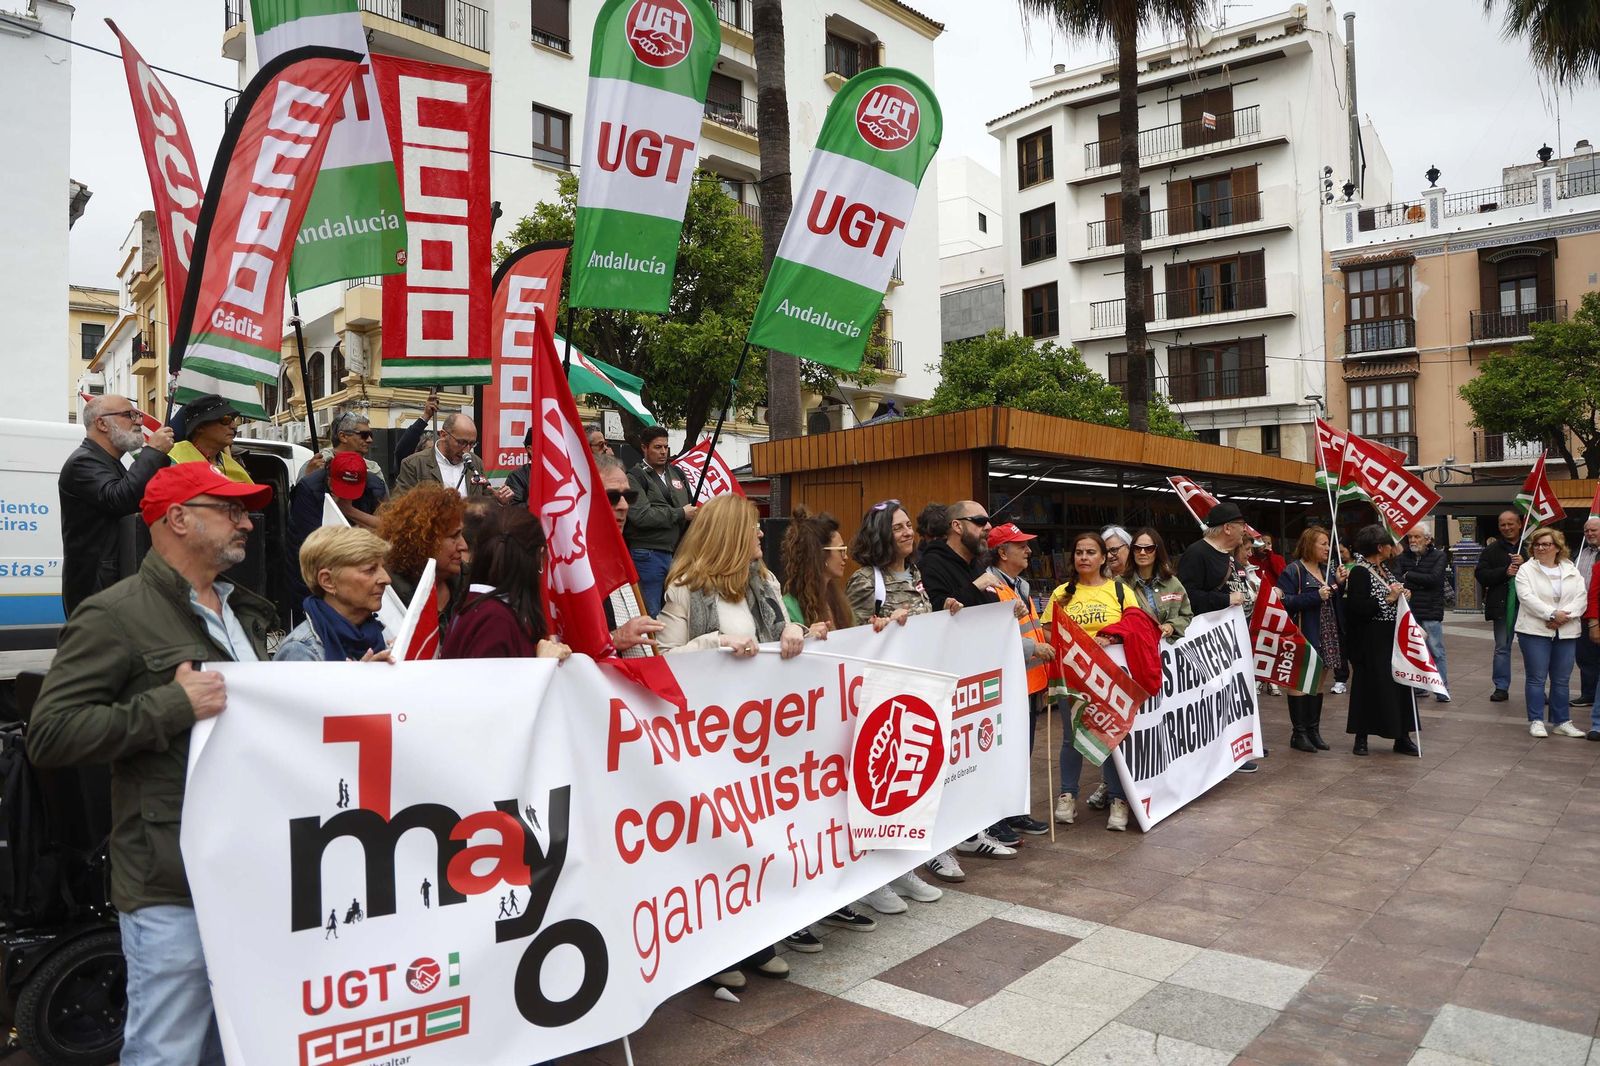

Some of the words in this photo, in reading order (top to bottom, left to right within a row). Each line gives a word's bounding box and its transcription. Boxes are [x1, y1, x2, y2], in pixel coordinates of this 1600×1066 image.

[635, 2, 687, 41] UGT
[870, 91, 916, 131] UGT
[597, 121, 695, 184] UGT
[221, 81, 330, 315] CCOO
[399, 75, 470, 358] CCOO
[806, 190, 905, 258] UGT
[587, 250, 665, 275] Andalucía
[211, 307, 262, 341] Cádiz
[776, 299, 861, 338] Andalucía
[499, 275, 548, 448] CCOO
[499, 452, 532, 466] Cádi
[684, 453, 730, 497] UGT
[1344, 442, 1428, 516] CCOO
[607, 686, 824, 773] Proteger
[889, 710, 936, 798] UGT
[949, 722, 974, 766] GT
[615, 750, 850, 864] conquista
[852, 824, 926, 839] ww.UGT.es
[289, 785, 609, 1029] mayo
[633, 853, 775, 984] ganar
[302, 963, 397, 1016] UGT
[306, 1015, 419, 1066] CCOO
